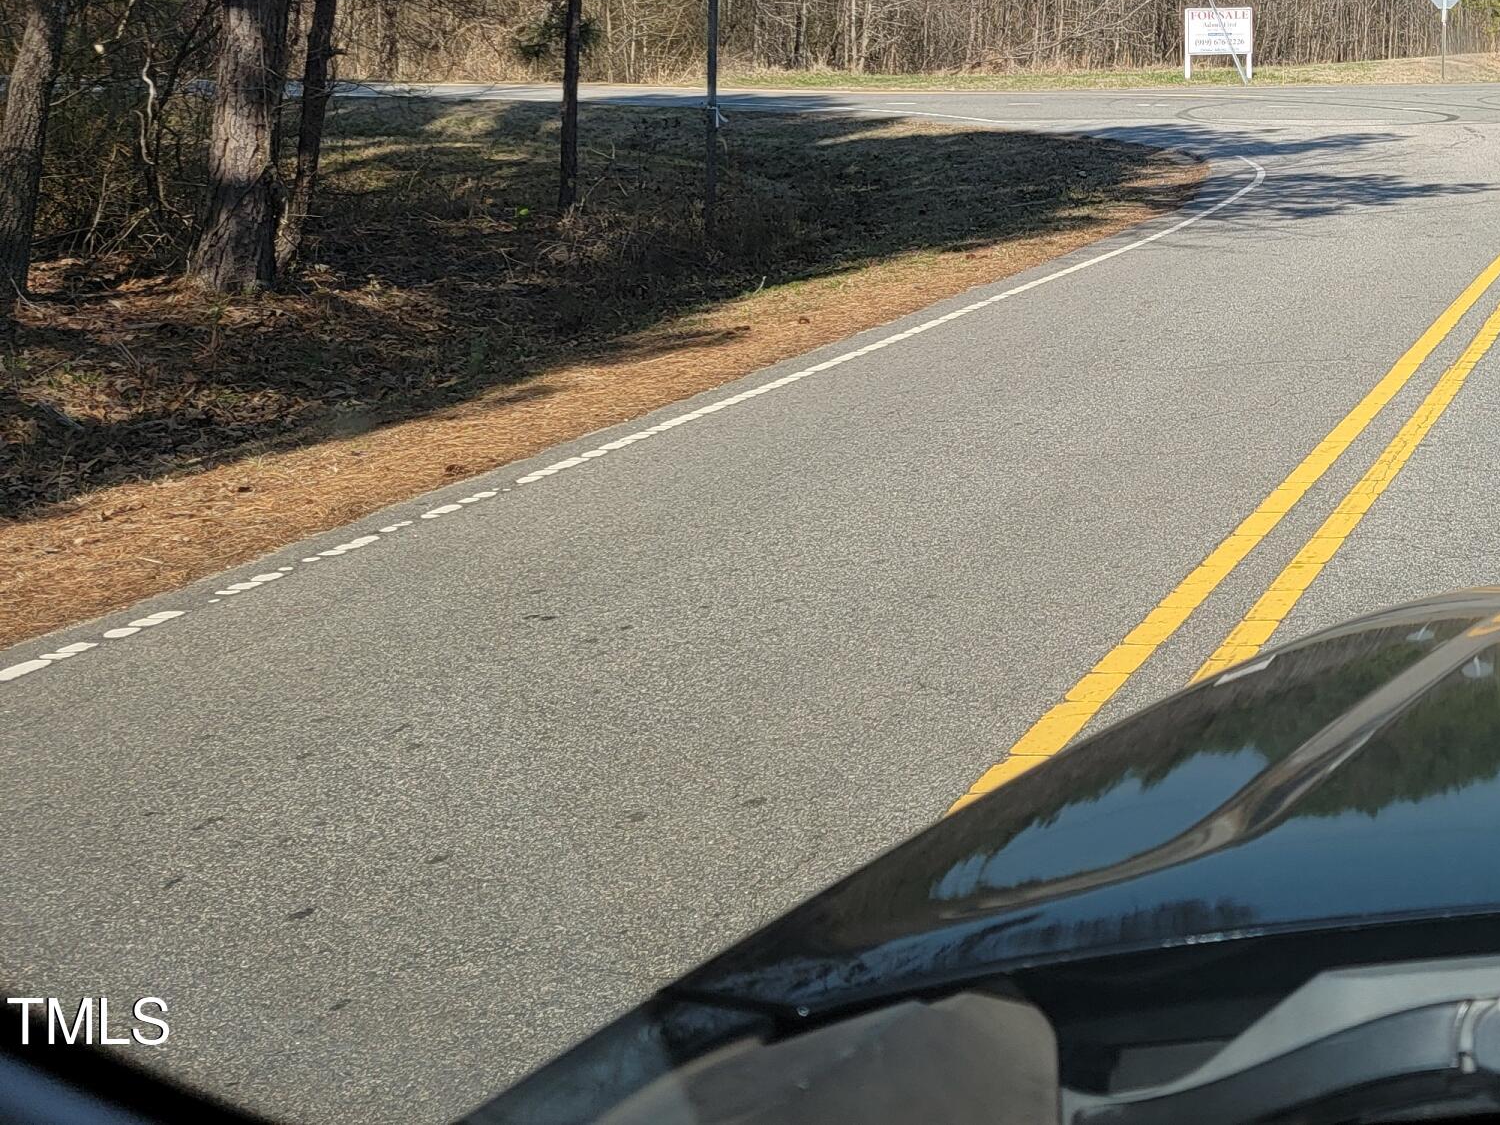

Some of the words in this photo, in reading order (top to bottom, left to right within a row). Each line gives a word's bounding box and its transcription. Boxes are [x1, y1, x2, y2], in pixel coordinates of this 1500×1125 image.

[1191, 11, 1215, 20] FOR
[1217, 11, 1249, 19] SALE
[1194, 38, 1212, 47] (919)
[1213, 38, 1245, 46] 6762226
